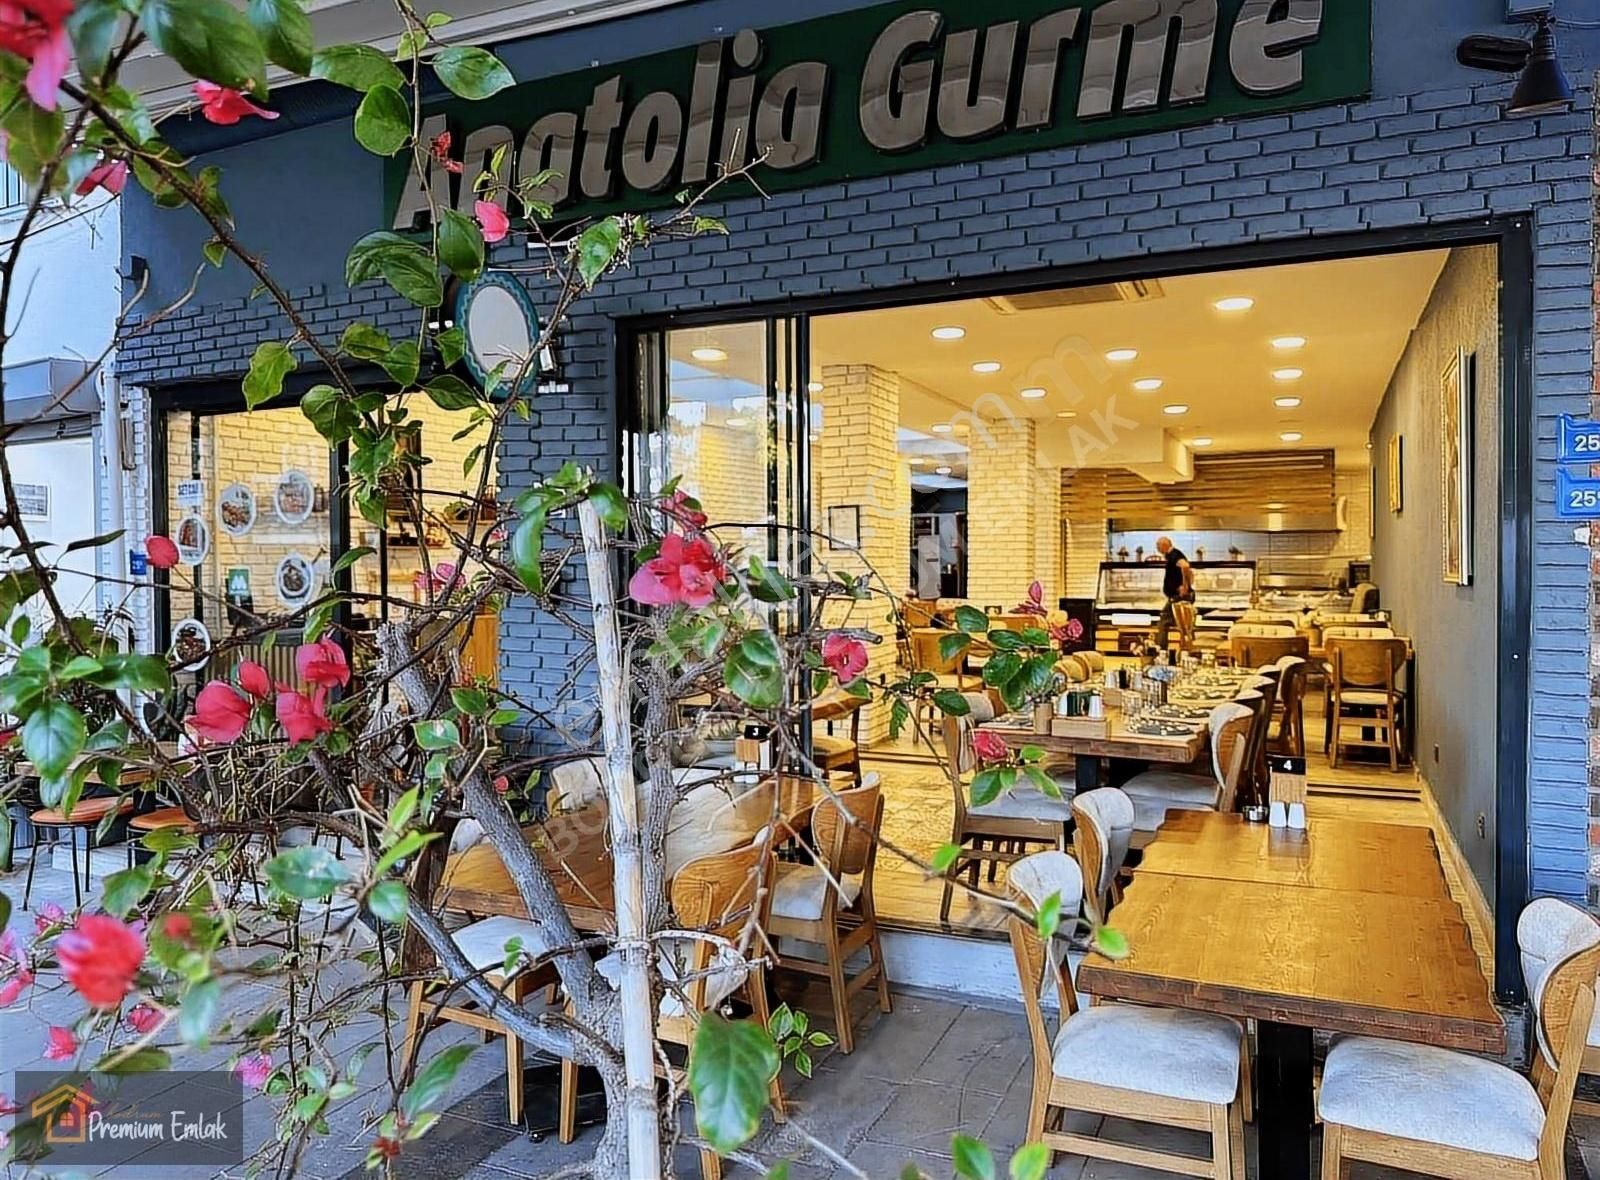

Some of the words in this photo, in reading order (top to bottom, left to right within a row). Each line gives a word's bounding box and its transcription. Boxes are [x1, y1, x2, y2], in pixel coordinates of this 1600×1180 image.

[393, 29, 830, 230] Anatolia
[859, 0, 1322, 152] Gurme
[1570, 490, 1600, 508] 25
[1283, 759, 1293, 771] 4
